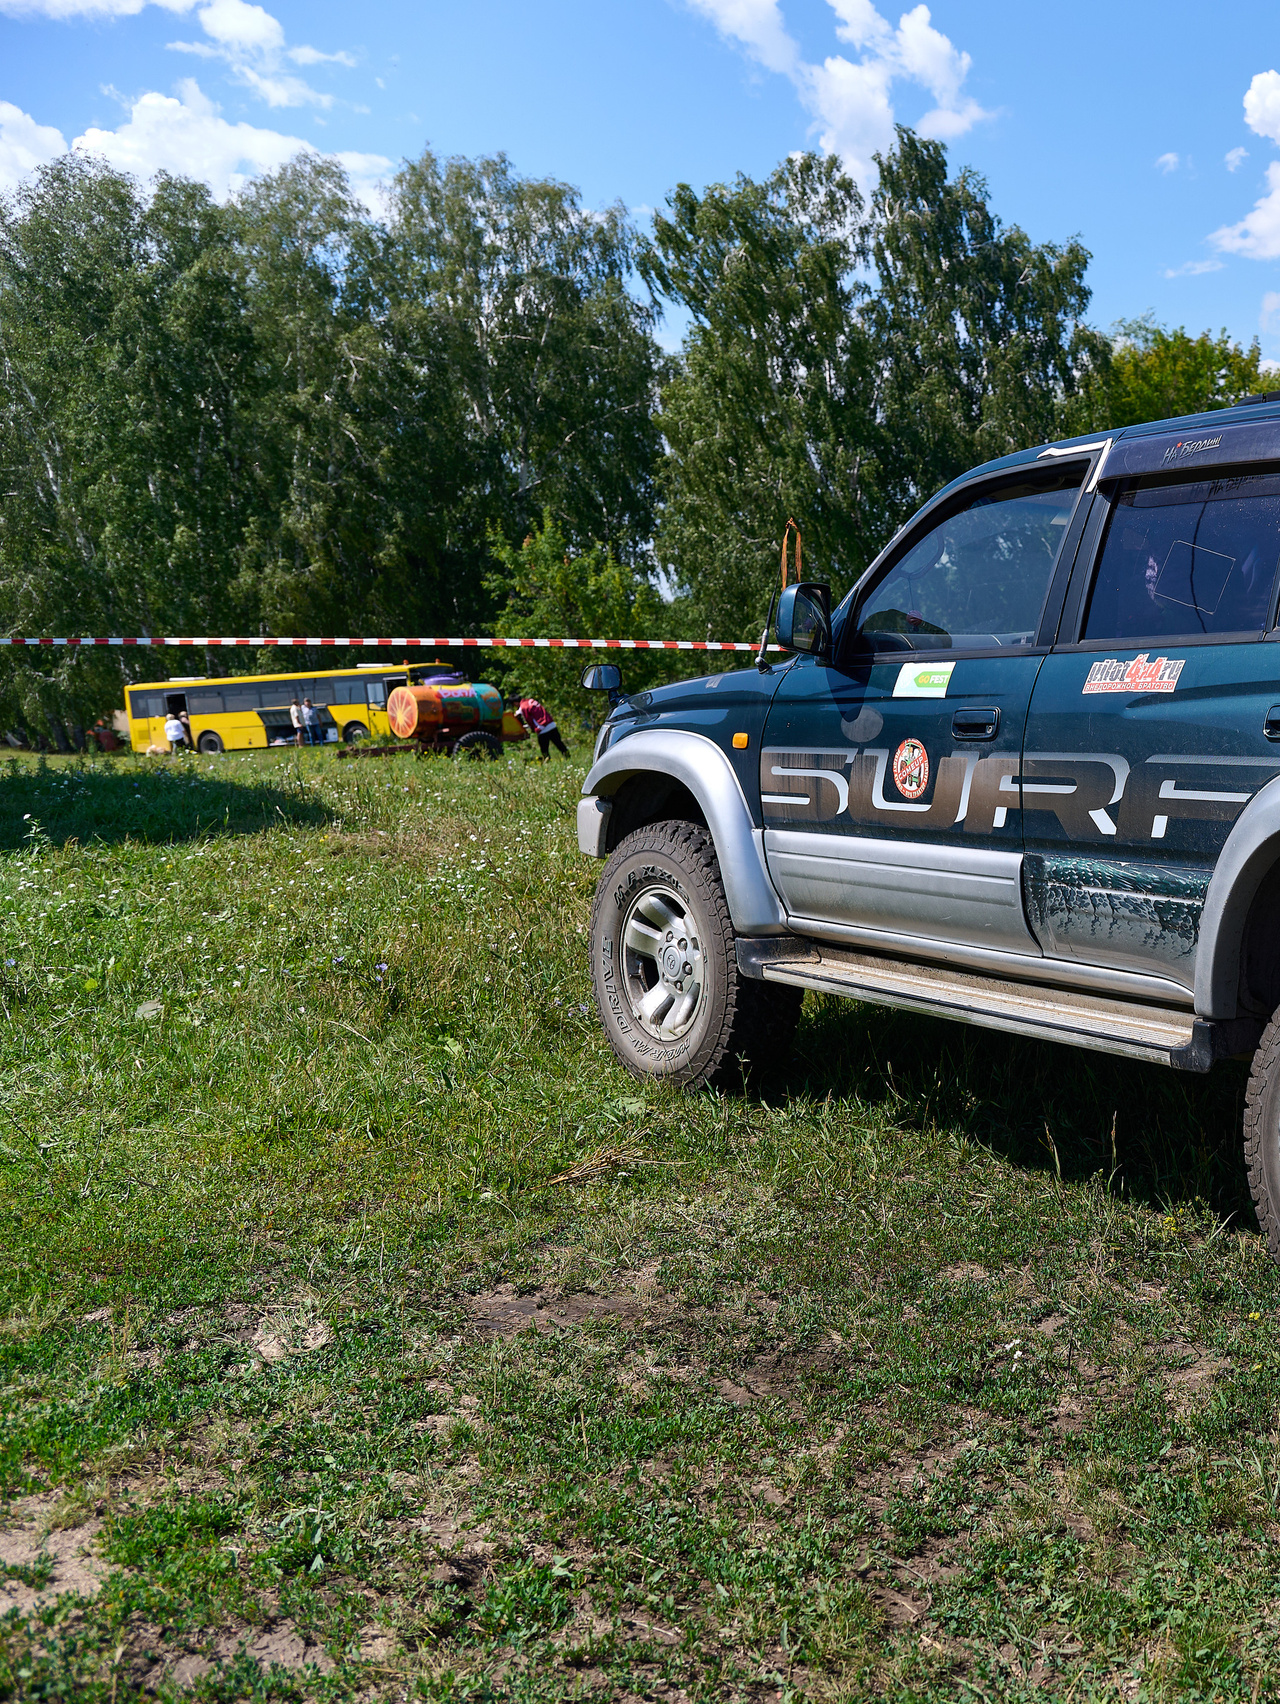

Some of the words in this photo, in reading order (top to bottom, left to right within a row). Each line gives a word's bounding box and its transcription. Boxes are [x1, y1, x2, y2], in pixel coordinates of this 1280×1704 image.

[918, 675, 930, 684] GO
[929, 675, 949, 684] FEST
[1085, 682, 1135, 691] ВНЕДОРОЖНОЕ
[1138, 681, 1174, 690] БРАТСТВО
[899, 756, 923, 779] COMEUP
